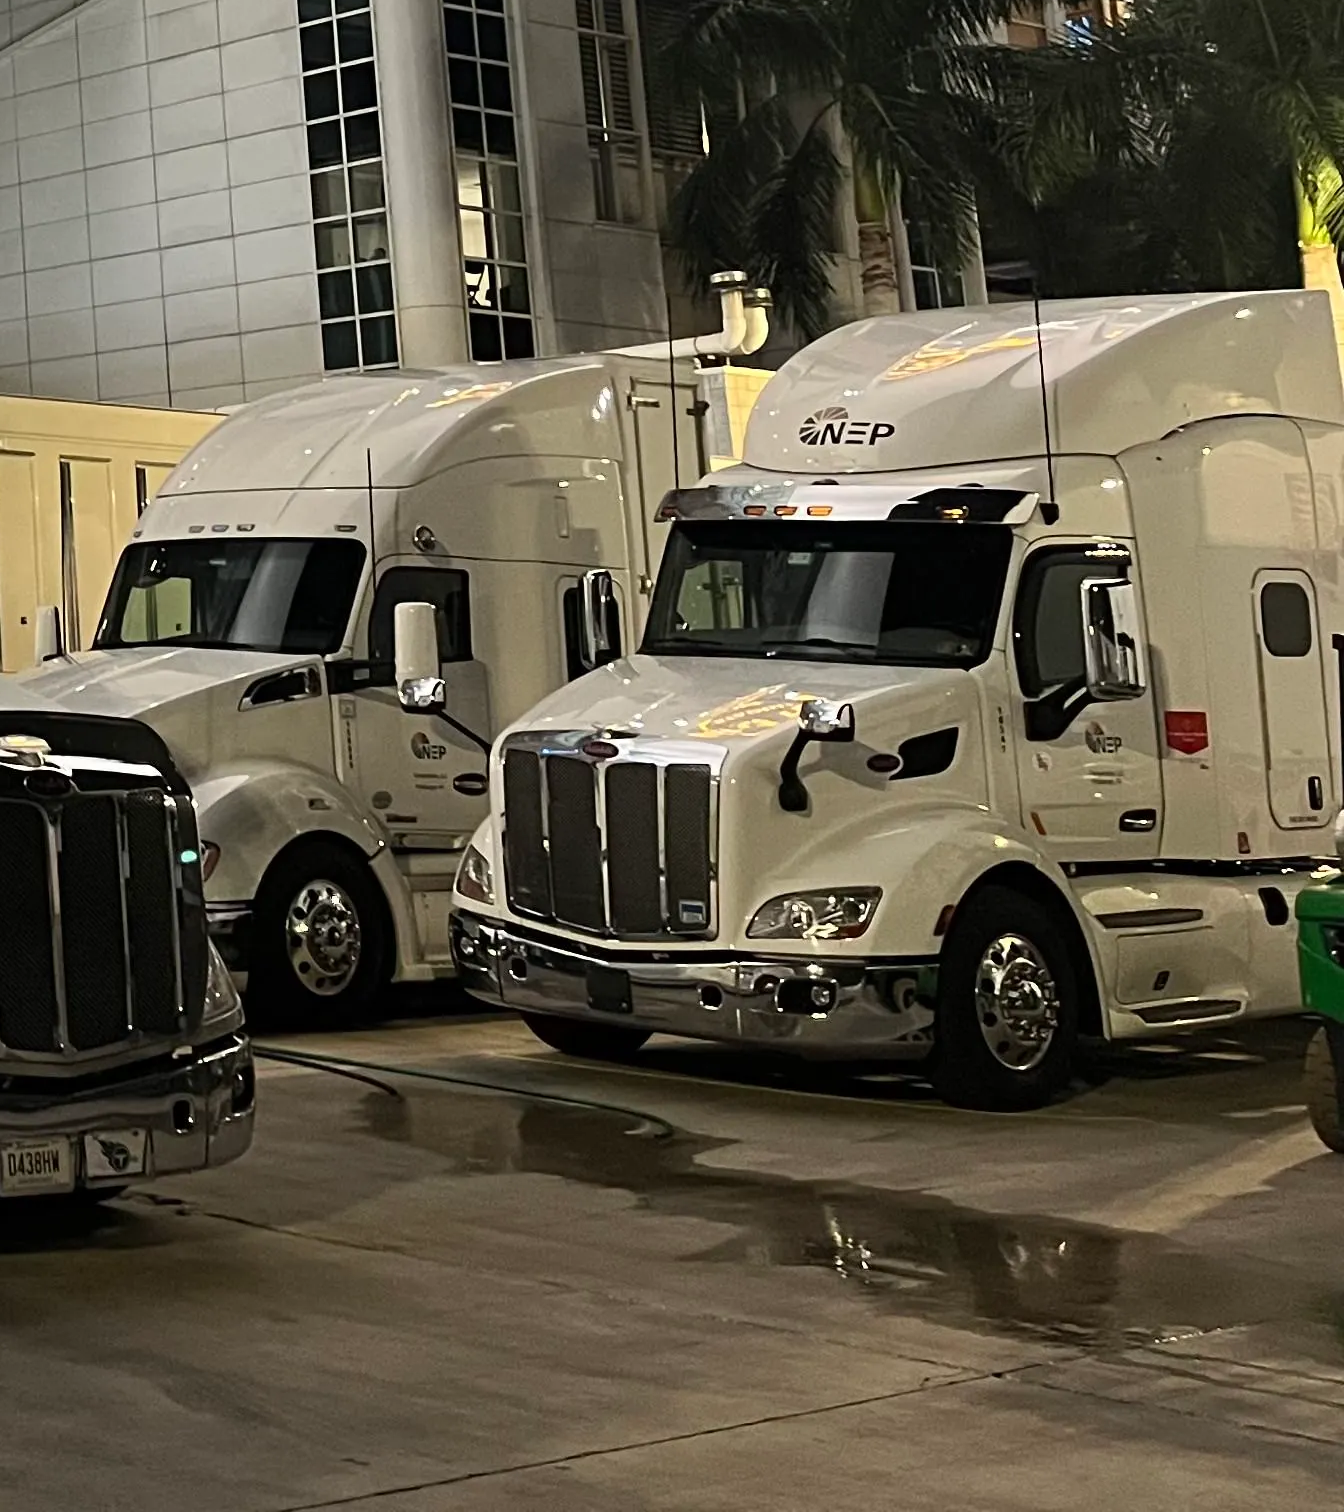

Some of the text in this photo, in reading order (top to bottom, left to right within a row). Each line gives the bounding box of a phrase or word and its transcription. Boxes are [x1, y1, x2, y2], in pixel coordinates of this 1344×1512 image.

[820, 422, 895, 446] NEP
[422, 744, 447, 760] NEP
[1095, 736, 1122, 753] NEP
